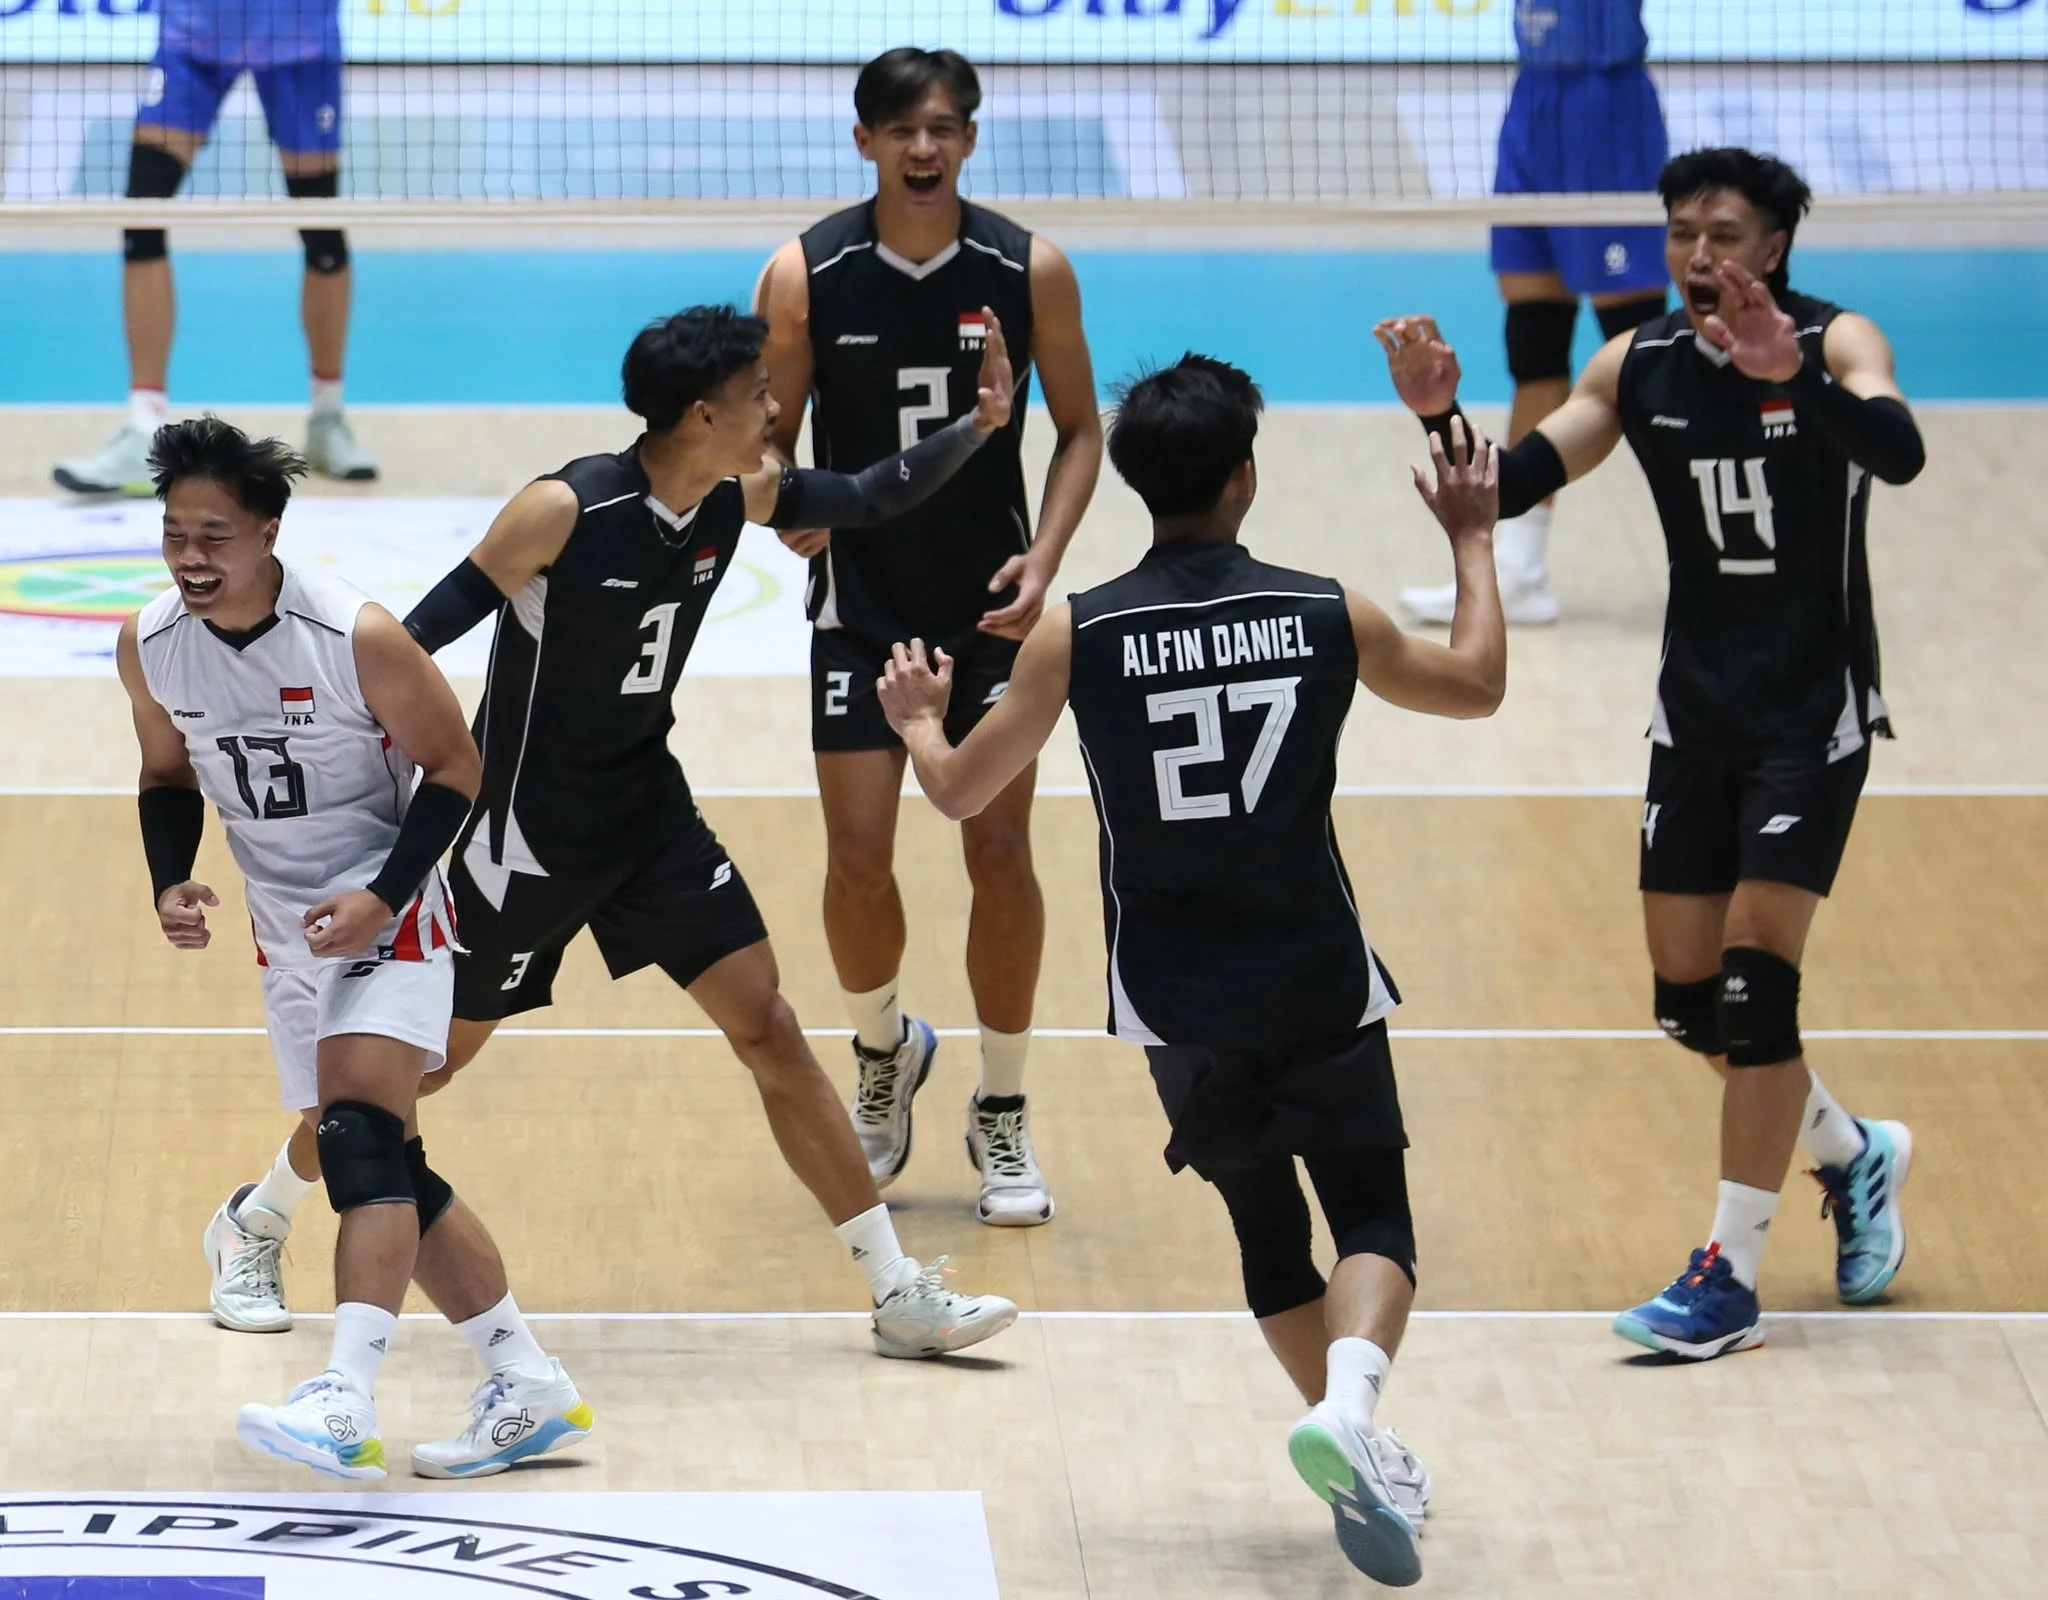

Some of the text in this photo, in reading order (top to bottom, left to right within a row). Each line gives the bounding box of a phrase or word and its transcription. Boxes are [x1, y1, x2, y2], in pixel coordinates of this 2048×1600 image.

[960, 338, 986, 351] IN
[897, 367, 952, 453] 2
[1764, 423, 1797, 440] INA
[1689, 457, 1776, 551] 14
[693, 570, 714, 586] INA
[620, 602, 681, 695] 3
[1123, 615, 1314, 677] ALFIN DANIEL
[824, 671, 852, 716] 2
[284, 715, 315, 726] INA
[1146, 676, 1302, 821] 27
[216, 735, 308, 819] 13
[1643, 801, 1662, 850] 4
[500, 951, 535, 991] 3
